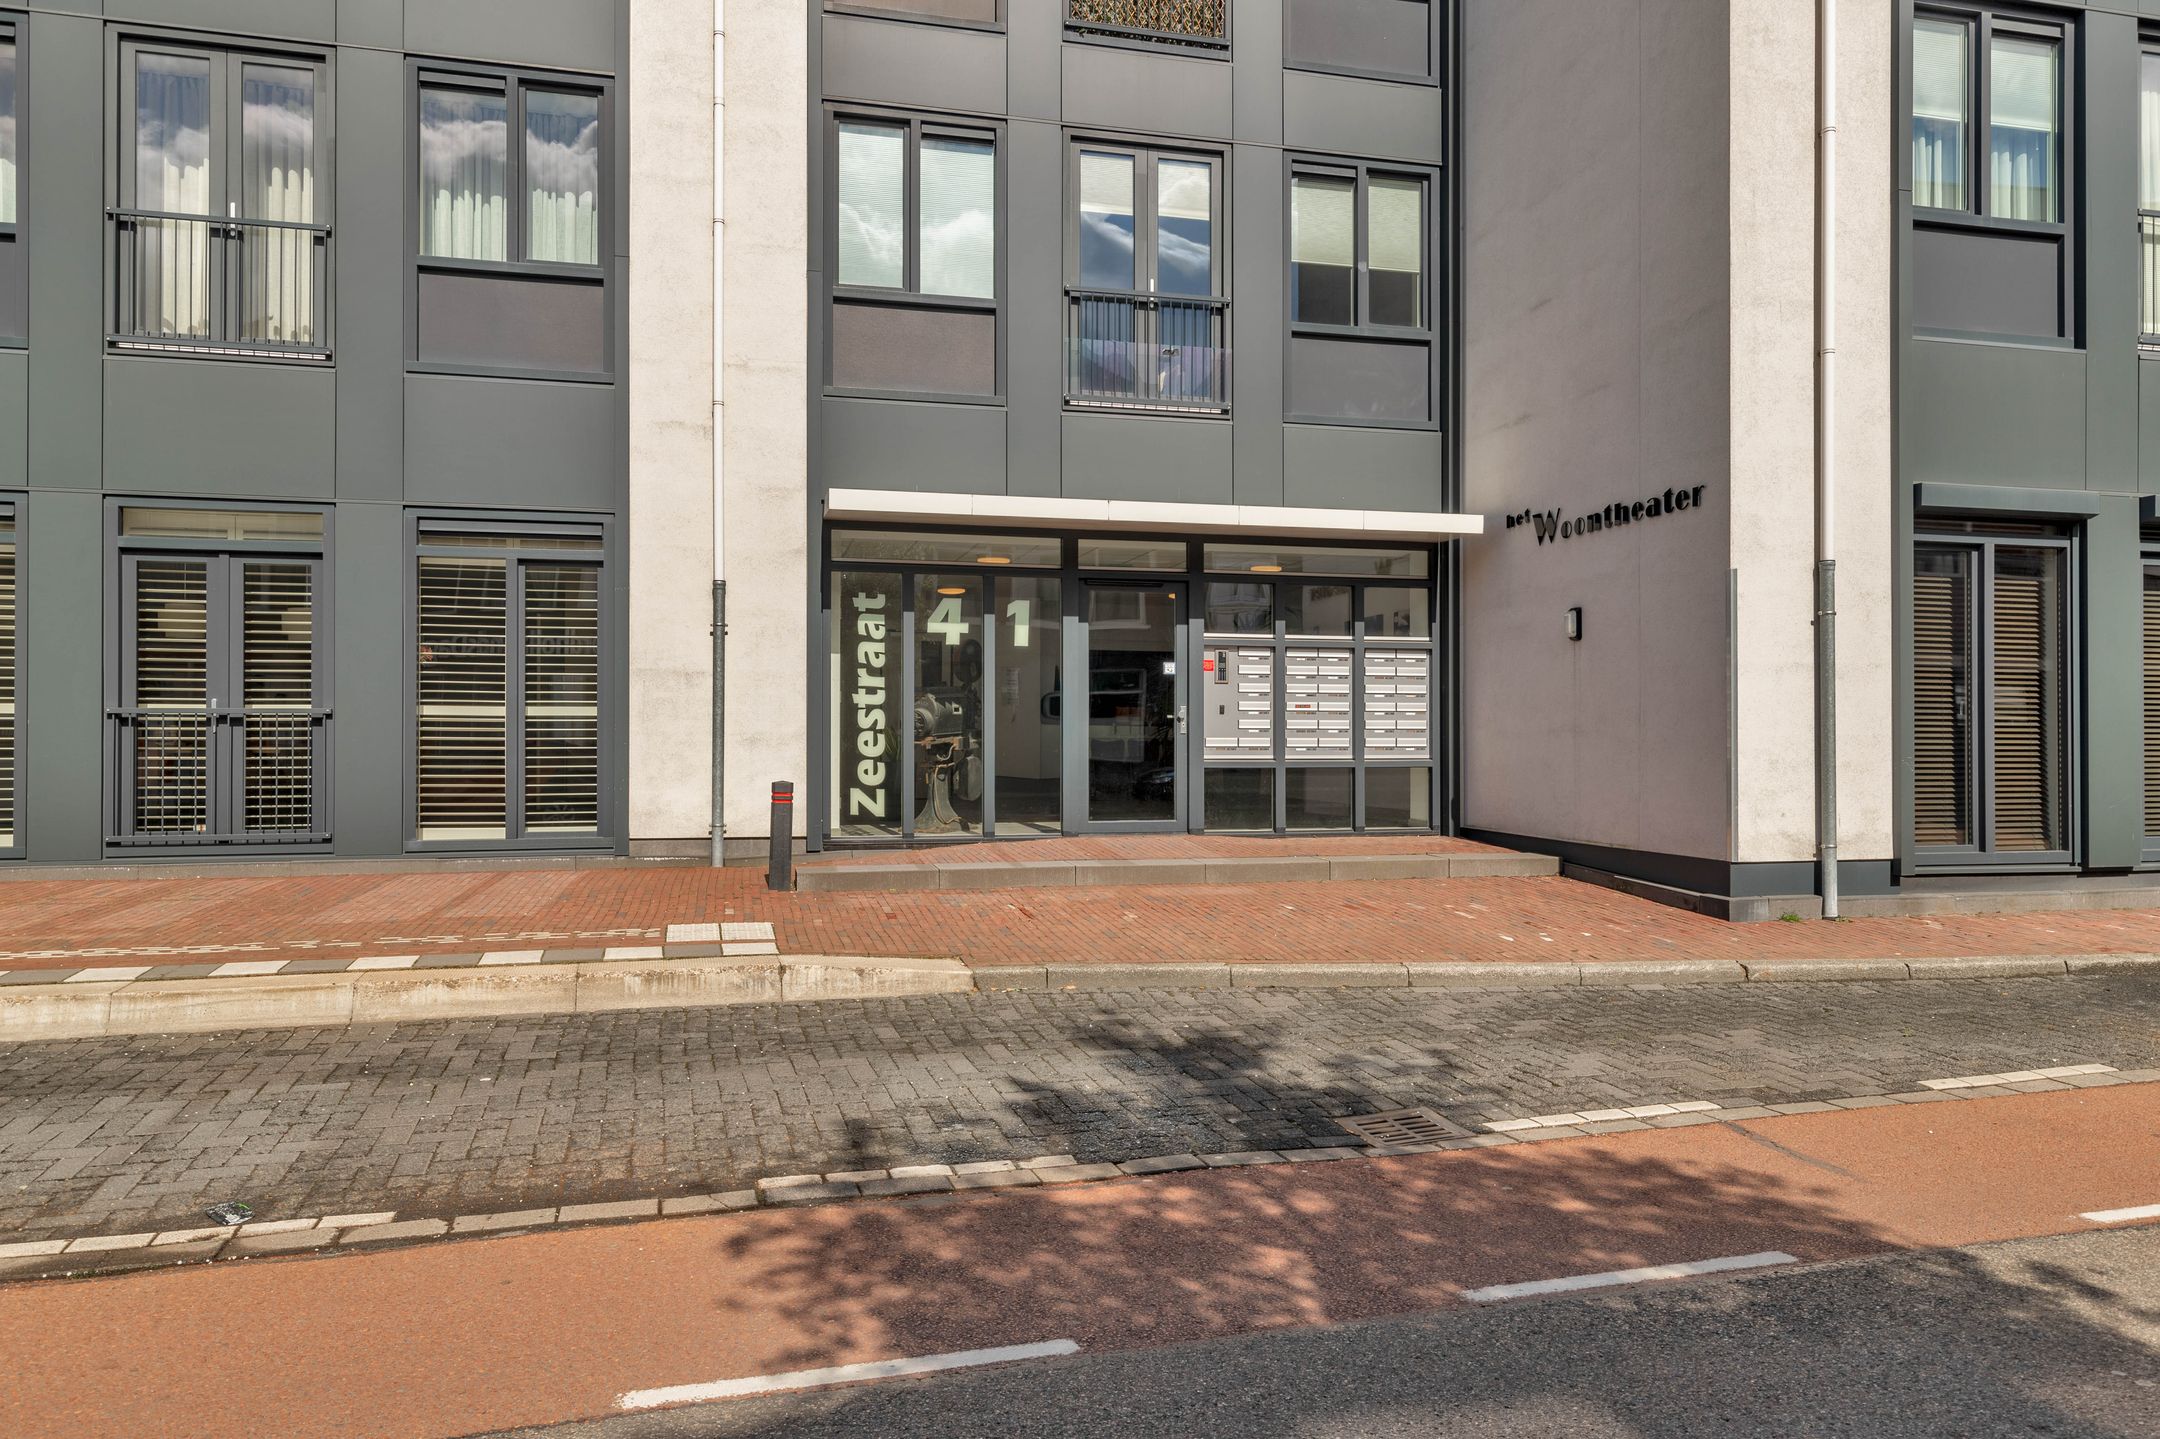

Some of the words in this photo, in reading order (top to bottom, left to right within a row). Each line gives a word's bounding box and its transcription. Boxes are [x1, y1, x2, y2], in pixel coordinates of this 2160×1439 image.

[1505, 508, 1531, 529] het
[1532, 484, 1705, 547] Woontheater
[849, 591, 886, 818] Zeestraat
